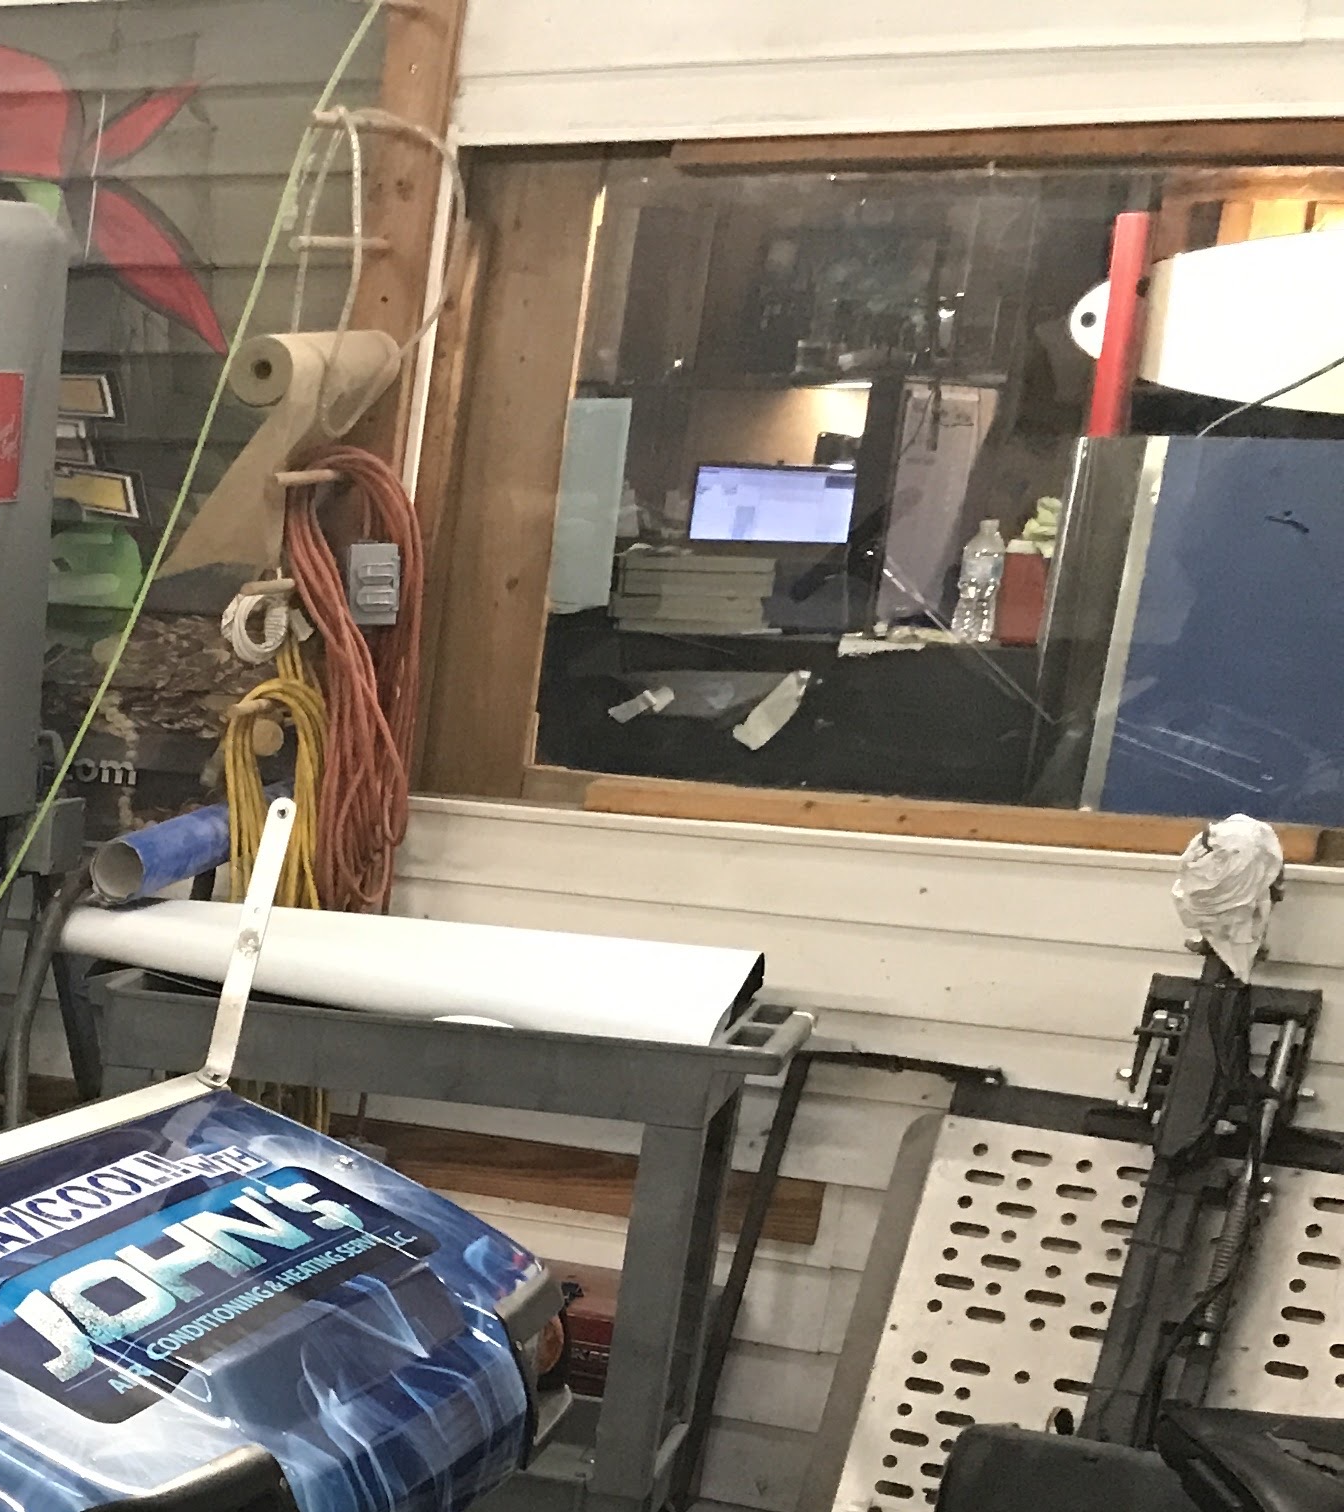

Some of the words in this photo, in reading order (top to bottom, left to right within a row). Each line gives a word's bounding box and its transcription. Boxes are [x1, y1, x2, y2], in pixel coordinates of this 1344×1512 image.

[13, 1182, 364, 1383] JOHN'S
[108, 1364, 153, 1395] AIR
[146, 1285, 274, 1361] CONDITIONING
[264, 1280, 286, 1295] &
[276, 1251, 346, 1287] HEATING
